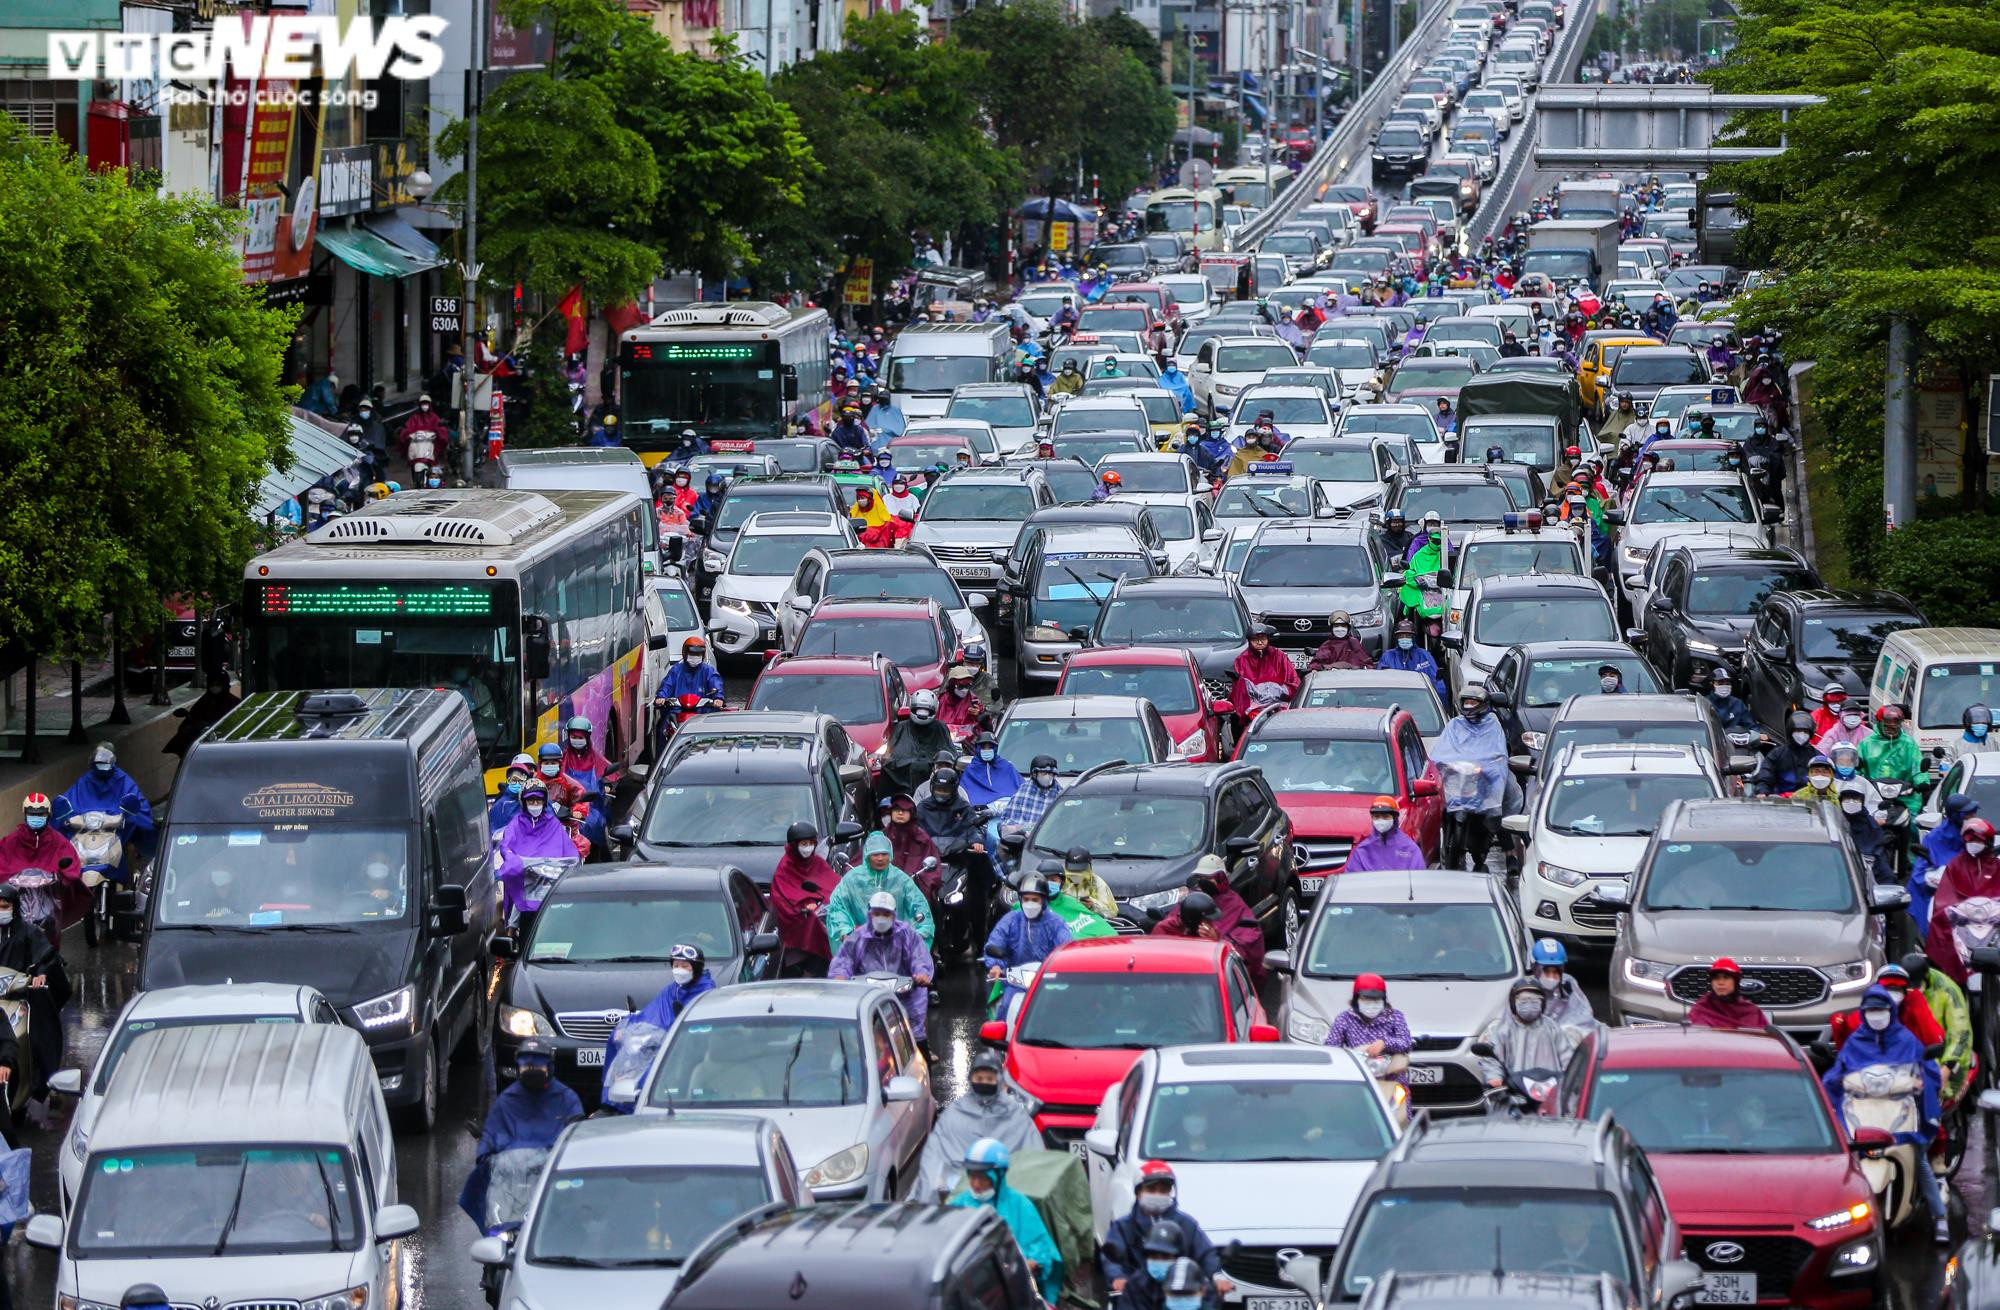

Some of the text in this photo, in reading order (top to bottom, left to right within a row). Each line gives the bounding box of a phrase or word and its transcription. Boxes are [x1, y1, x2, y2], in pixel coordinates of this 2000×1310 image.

[435, 299, 456, 313] 636
[432, 316, 459, 331] 630A
[284, 793, 354, 805] LIMOUSINE
[259, 807, 335, 817] CHARTER SERVICES
[1713, 1275, 1740, 1288] 30H
[1702, 1290, 1750, 1303] 266.74
